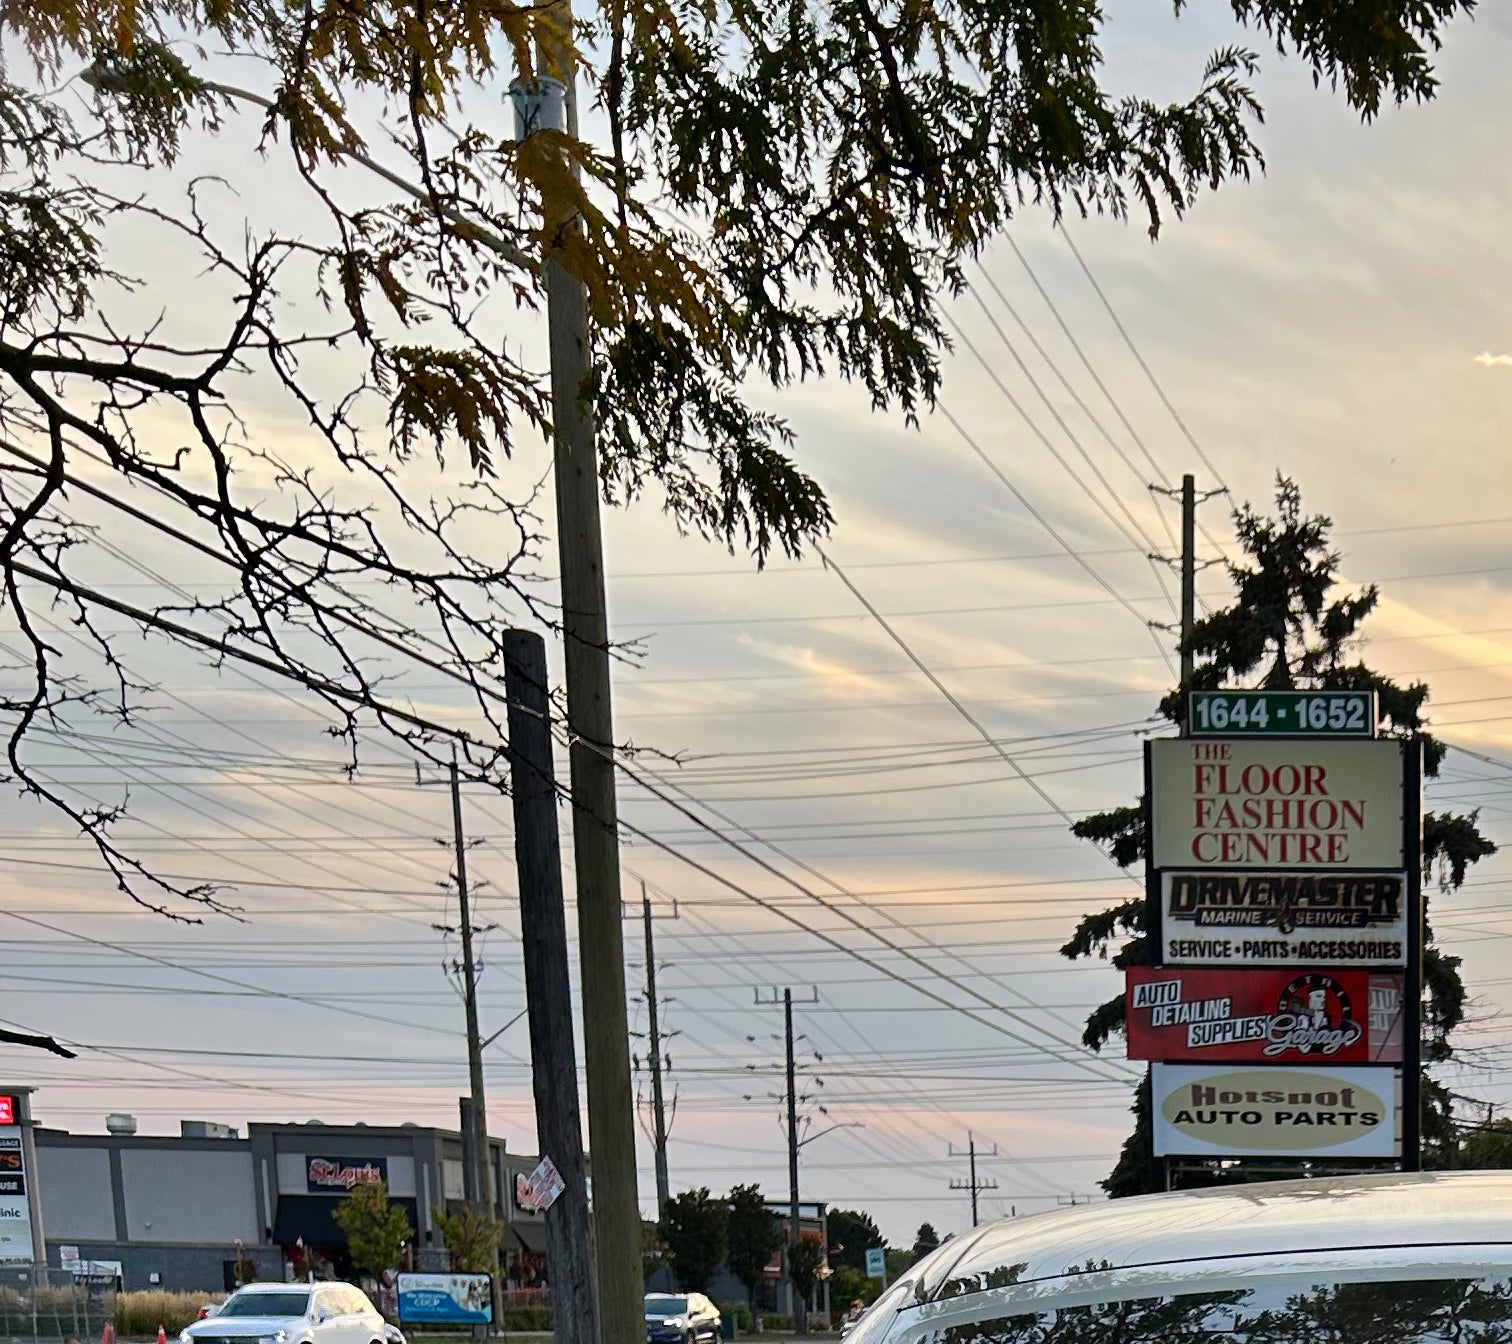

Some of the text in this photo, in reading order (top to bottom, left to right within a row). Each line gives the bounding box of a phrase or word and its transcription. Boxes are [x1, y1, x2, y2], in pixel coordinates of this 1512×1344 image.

[1197, 698, 1365, 729] 1644 1652
[1190, 743, 1232, 760] THE
[1193, 764, 1328, 796] FLOOR
[1193, 798, 1367, 830] FASHION
[1191, 832, 1350, 863] CENTRE
[1169, 876, 1402, 916] DRIVEMASTER
[1200, 911, 1361, 925] MARINE SERVICE
[1169, 941, 1402, 960] SERVICE PARTS ACCESSORIES
[1137, 982, 1179, 1006] AUTO
[1152, 998, 1231, 1027] DETAILING
[1191, 1018, 1265, 1045] SUPPLIES
[1262, 1013, 1363, 1056] Garage
[1173, 1110, 1380, 1126] AUTO PARTS
